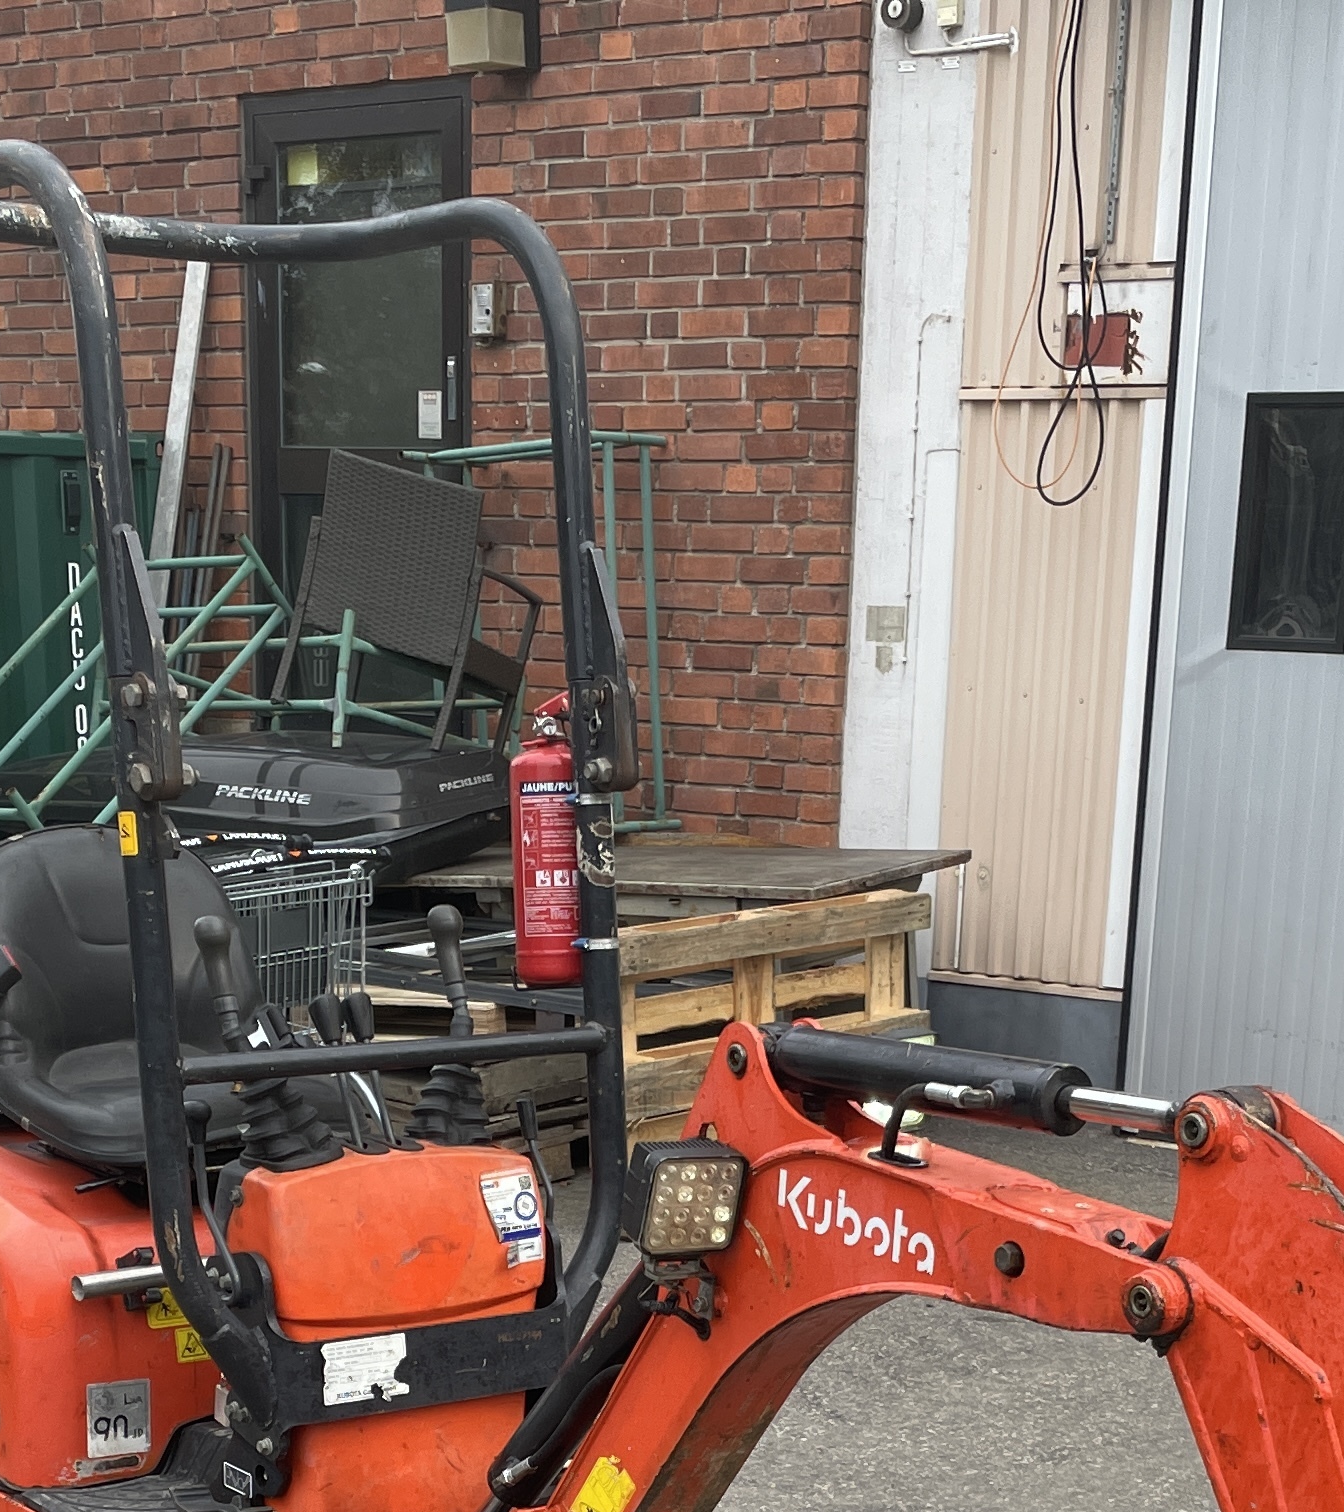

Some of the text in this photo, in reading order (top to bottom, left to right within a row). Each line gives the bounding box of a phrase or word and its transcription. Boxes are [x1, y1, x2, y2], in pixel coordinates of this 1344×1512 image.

[438, 773, 495, 793] PACKLINE
[215, 784, 312, 805] PACKLINE
[778, 1168, 935, 1276] Kubota
